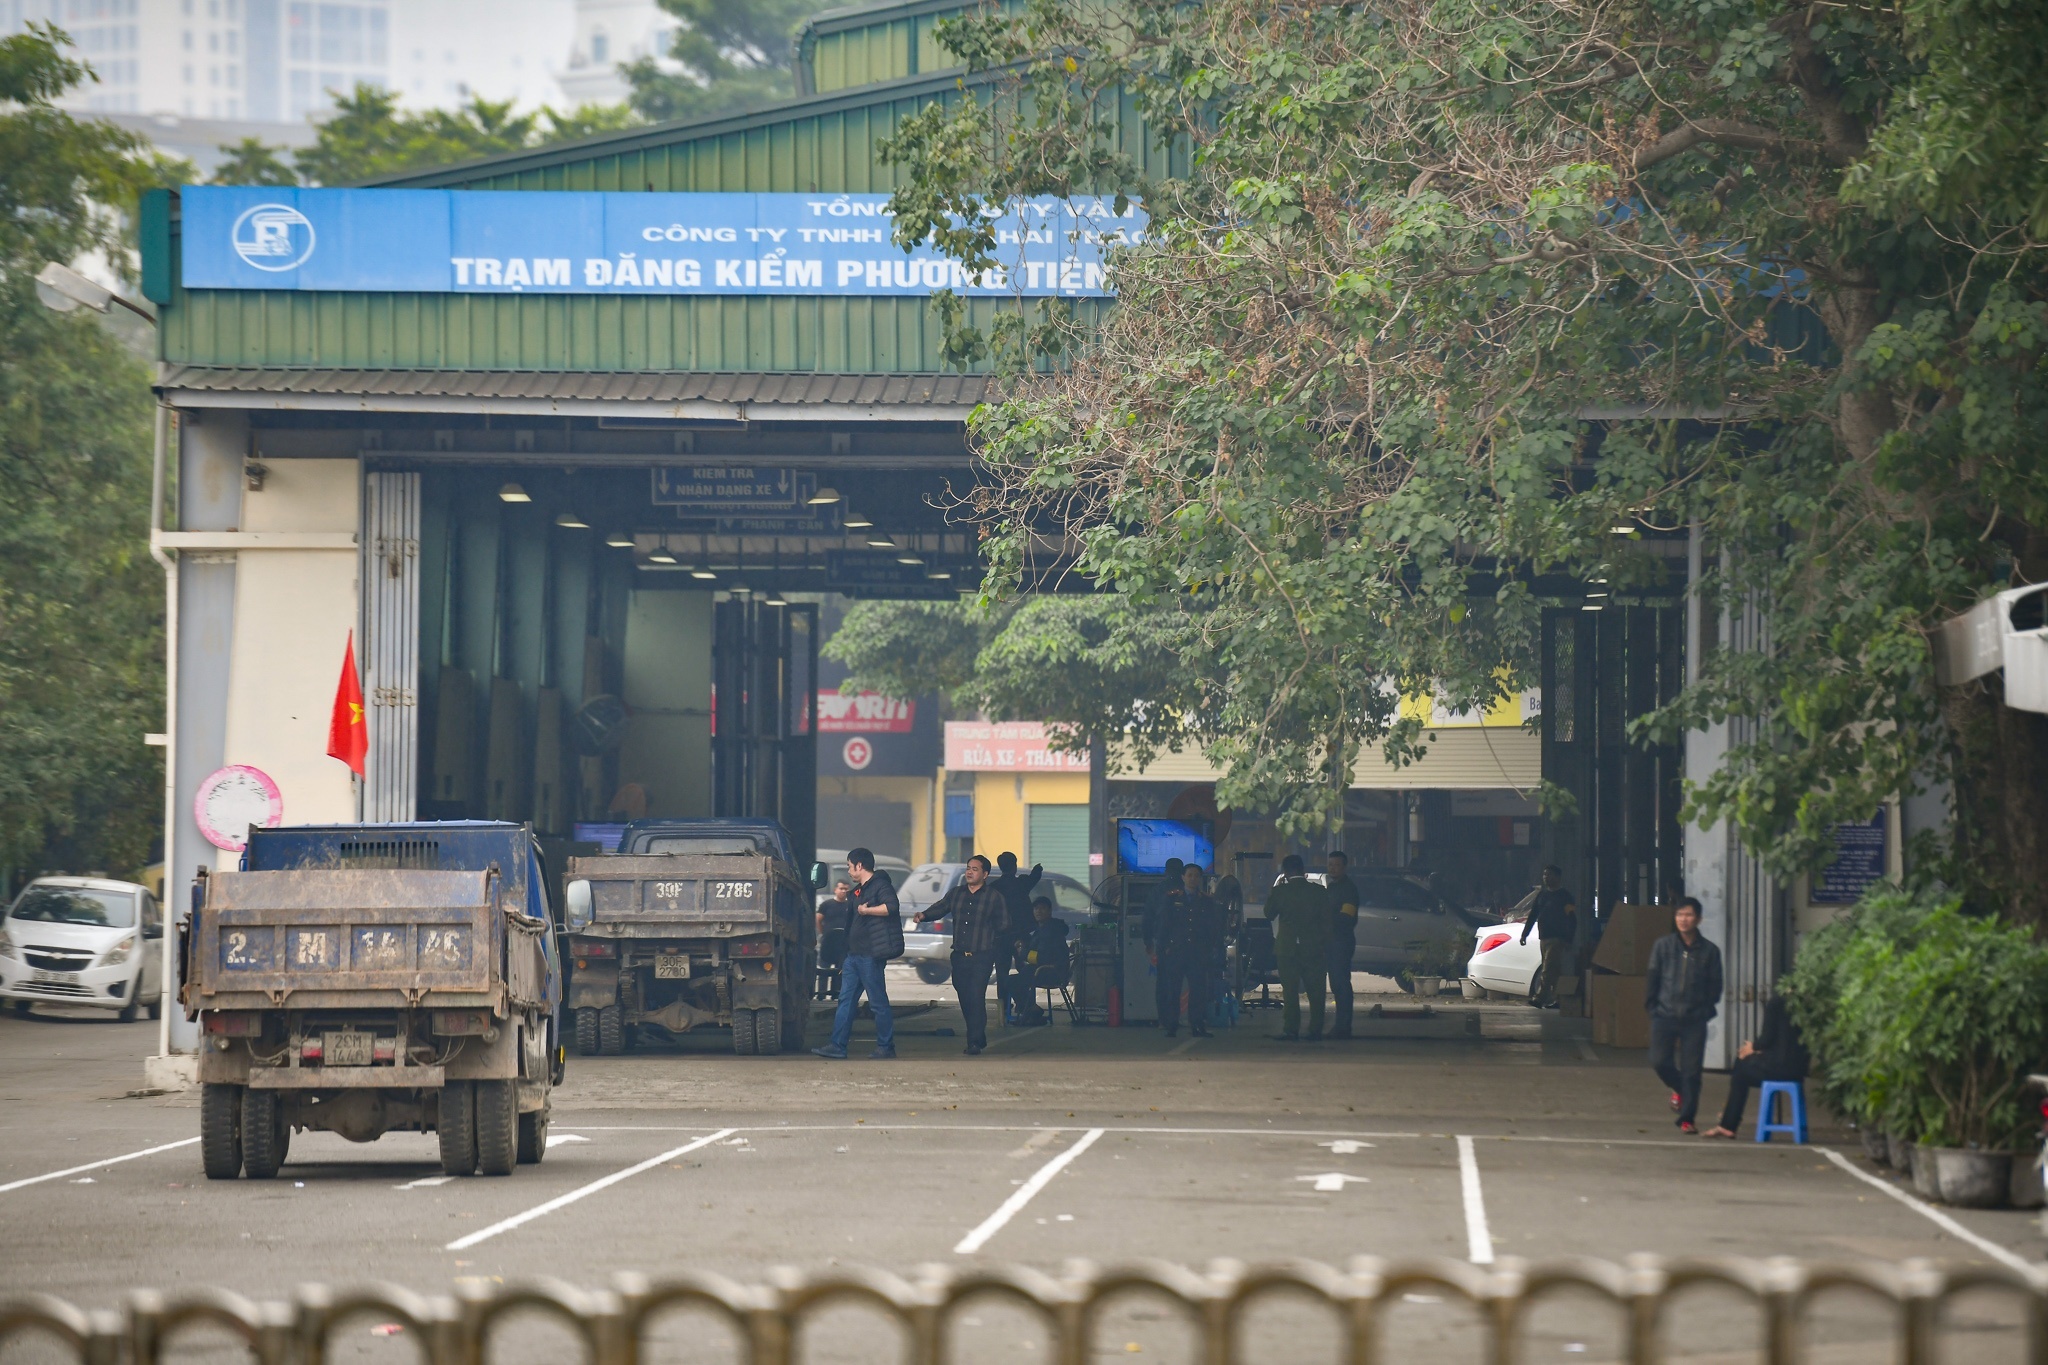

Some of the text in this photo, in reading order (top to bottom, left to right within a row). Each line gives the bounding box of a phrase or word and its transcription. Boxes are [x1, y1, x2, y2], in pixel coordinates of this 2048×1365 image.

[1016, 203, 1053, 218] TY
[642, 223, 737, 242] CÔNG
[745, 228, 788, 243] TY
[797, 228, 882, 243] TNHH
[982, 230, 1053, 244] HAI
[451, 257, 571, 291] TRẠM
[584, 252, 701, 287] ĐĂNG
[715, 247, 822, 287] KIỂM
[837, 257, 1007, 289] PHƯƠNG
[730, 468, 755, 479] TRA
[717, 485, 752, 498] DẠNG
[755, 485, 772, 495] XE
[996, 749, 1015, 766] XE
